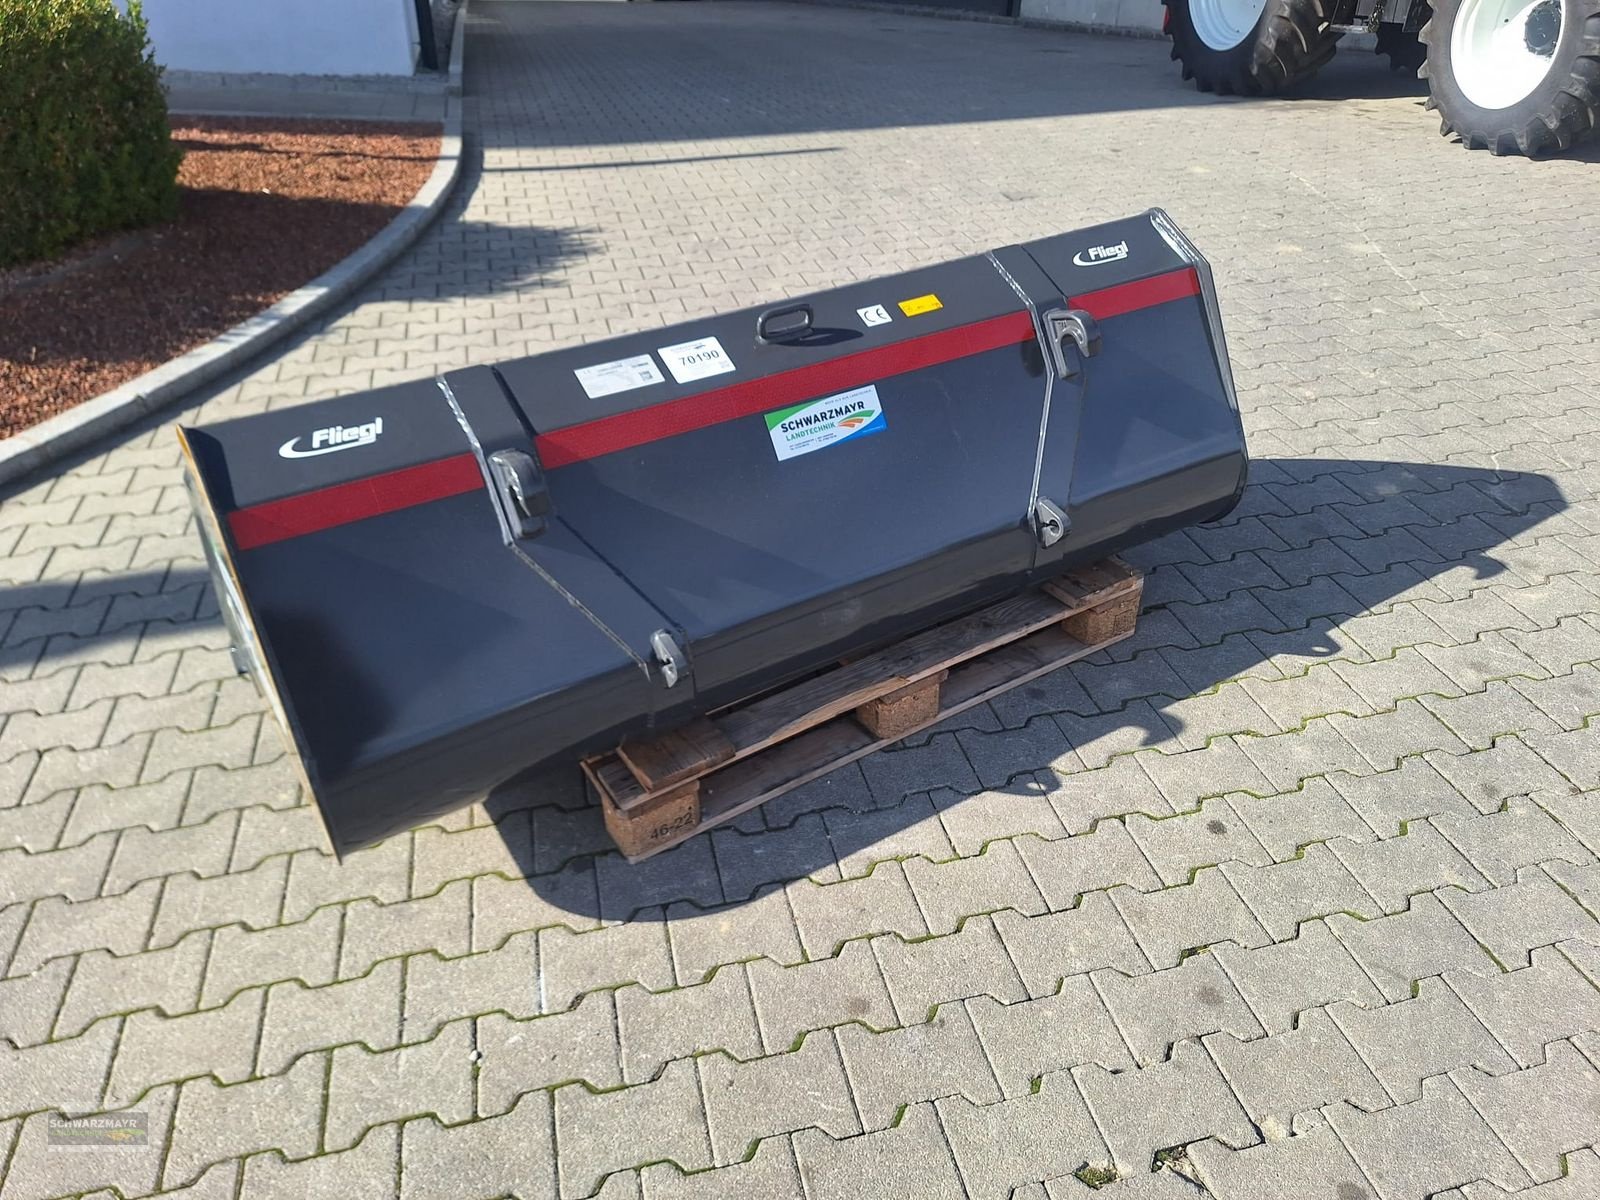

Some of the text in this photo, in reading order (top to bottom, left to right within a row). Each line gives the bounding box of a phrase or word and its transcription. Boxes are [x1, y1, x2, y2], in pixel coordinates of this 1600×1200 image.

[1088, 240, 1129, 260] Fliegl
[864, 308, 888, 323] CE
[679, 349, 720, 367] 70190
[780, 400, 866, 433] SCHWARZMAYR
[312, 417, 383, 449] Fliegl
[786, 421, 836, 441] LANDTECHNIK
[650, 811, 694, 839] 46-22
